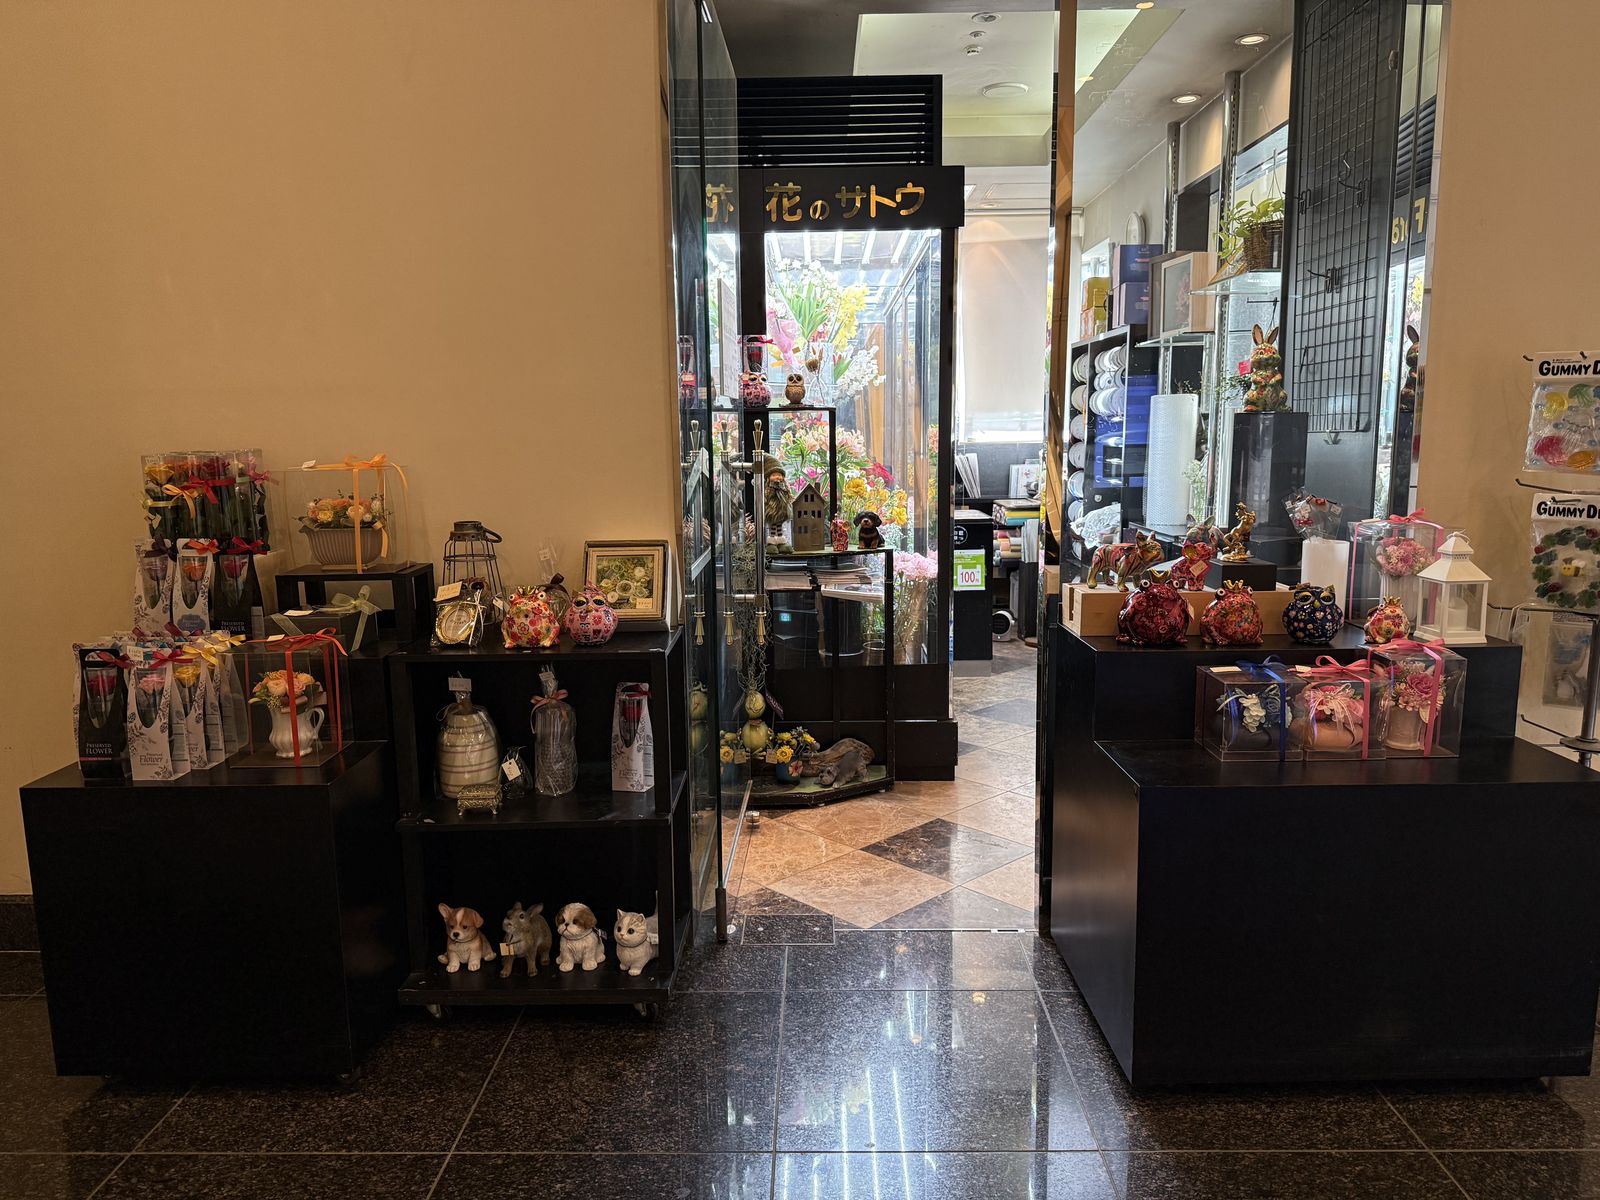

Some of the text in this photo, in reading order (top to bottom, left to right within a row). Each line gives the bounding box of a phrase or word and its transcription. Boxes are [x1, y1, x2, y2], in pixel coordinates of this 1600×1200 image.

[765, 182, 926, 222] 花のサトウ
[1538, 360, 1592, 377] GUMMY
[1536, 500, 1585, 519] GUMMY
